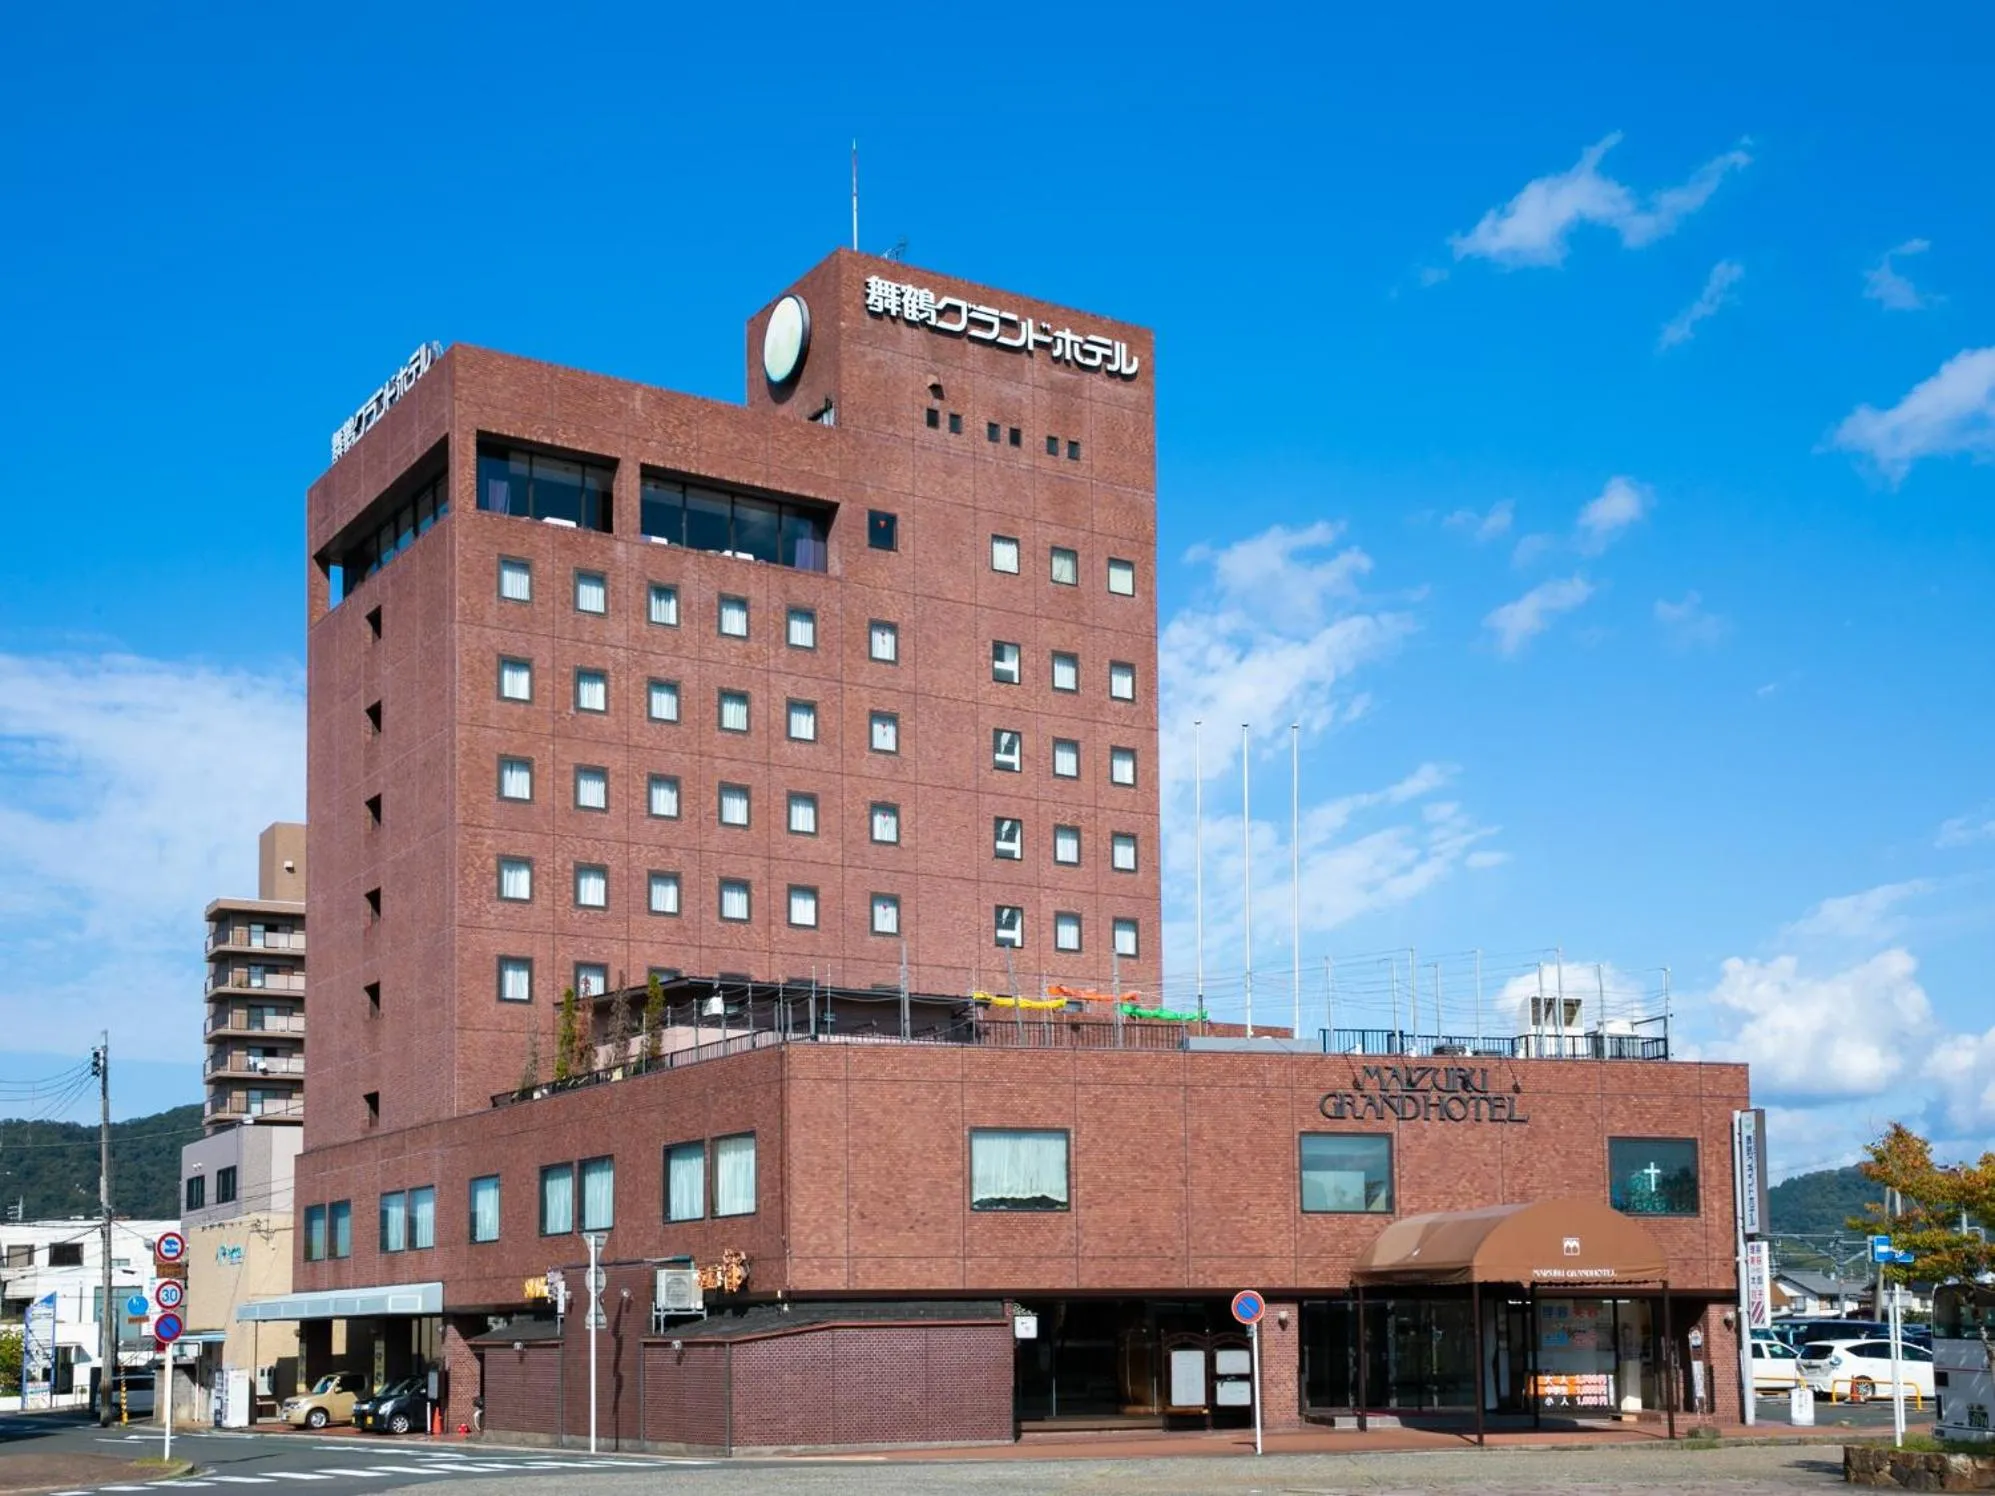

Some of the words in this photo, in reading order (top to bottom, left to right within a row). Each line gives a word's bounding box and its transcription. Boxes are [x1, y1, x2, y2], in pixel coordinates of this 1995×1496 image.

[866, 275, 1139, 375] 舞鶴グランドホテル
[161, 1288, 178, 1302] 30
